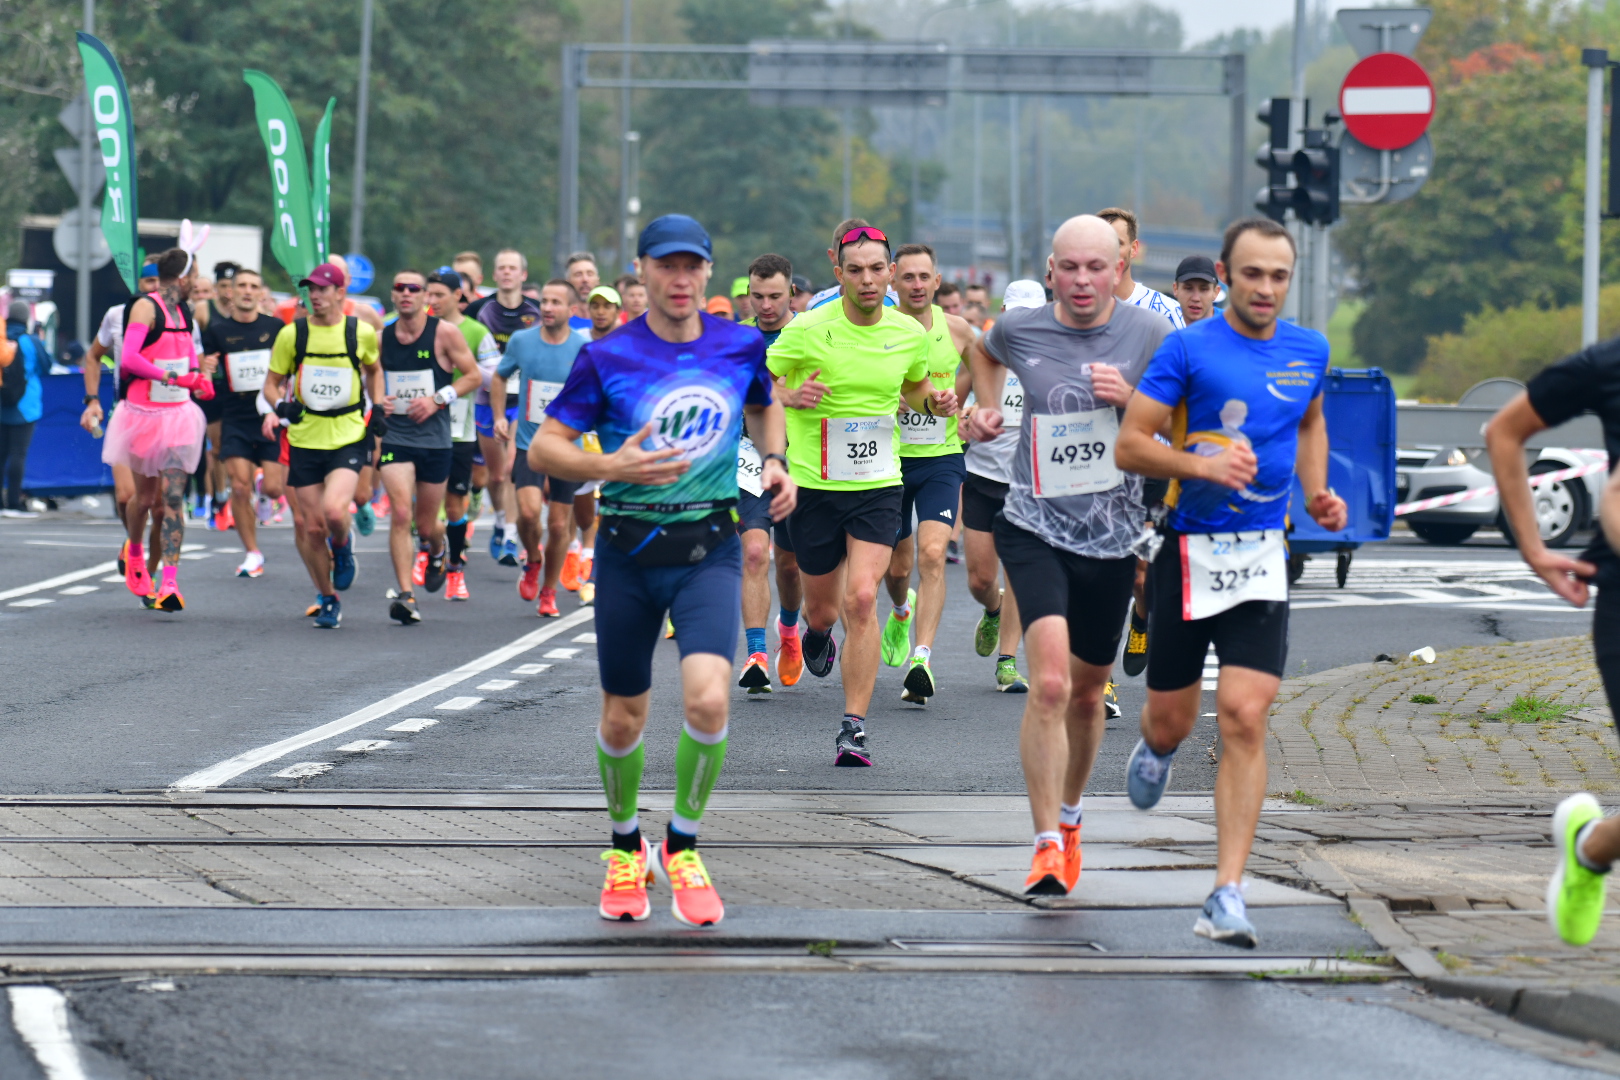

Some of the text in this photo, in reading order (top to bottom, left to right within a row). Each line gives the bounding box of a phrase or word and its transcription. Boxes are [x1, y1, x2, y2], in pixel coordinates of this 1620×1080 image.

[1007, 378, 1019, 386] 22
[310, 384, 342, 396] 4219
[396, 388, 427, 399] 4473
[900, 412, 937, 426] 3074
[844, 422, 859, 432] 22
[1051, 424, 1067, 437] 22
[847, 440, 878, 459] 328
[1051, 441, 1106, 465] 4939
[1212, 541, 1231, 555] 22
[1209, 565, 1268, 592] 3234
